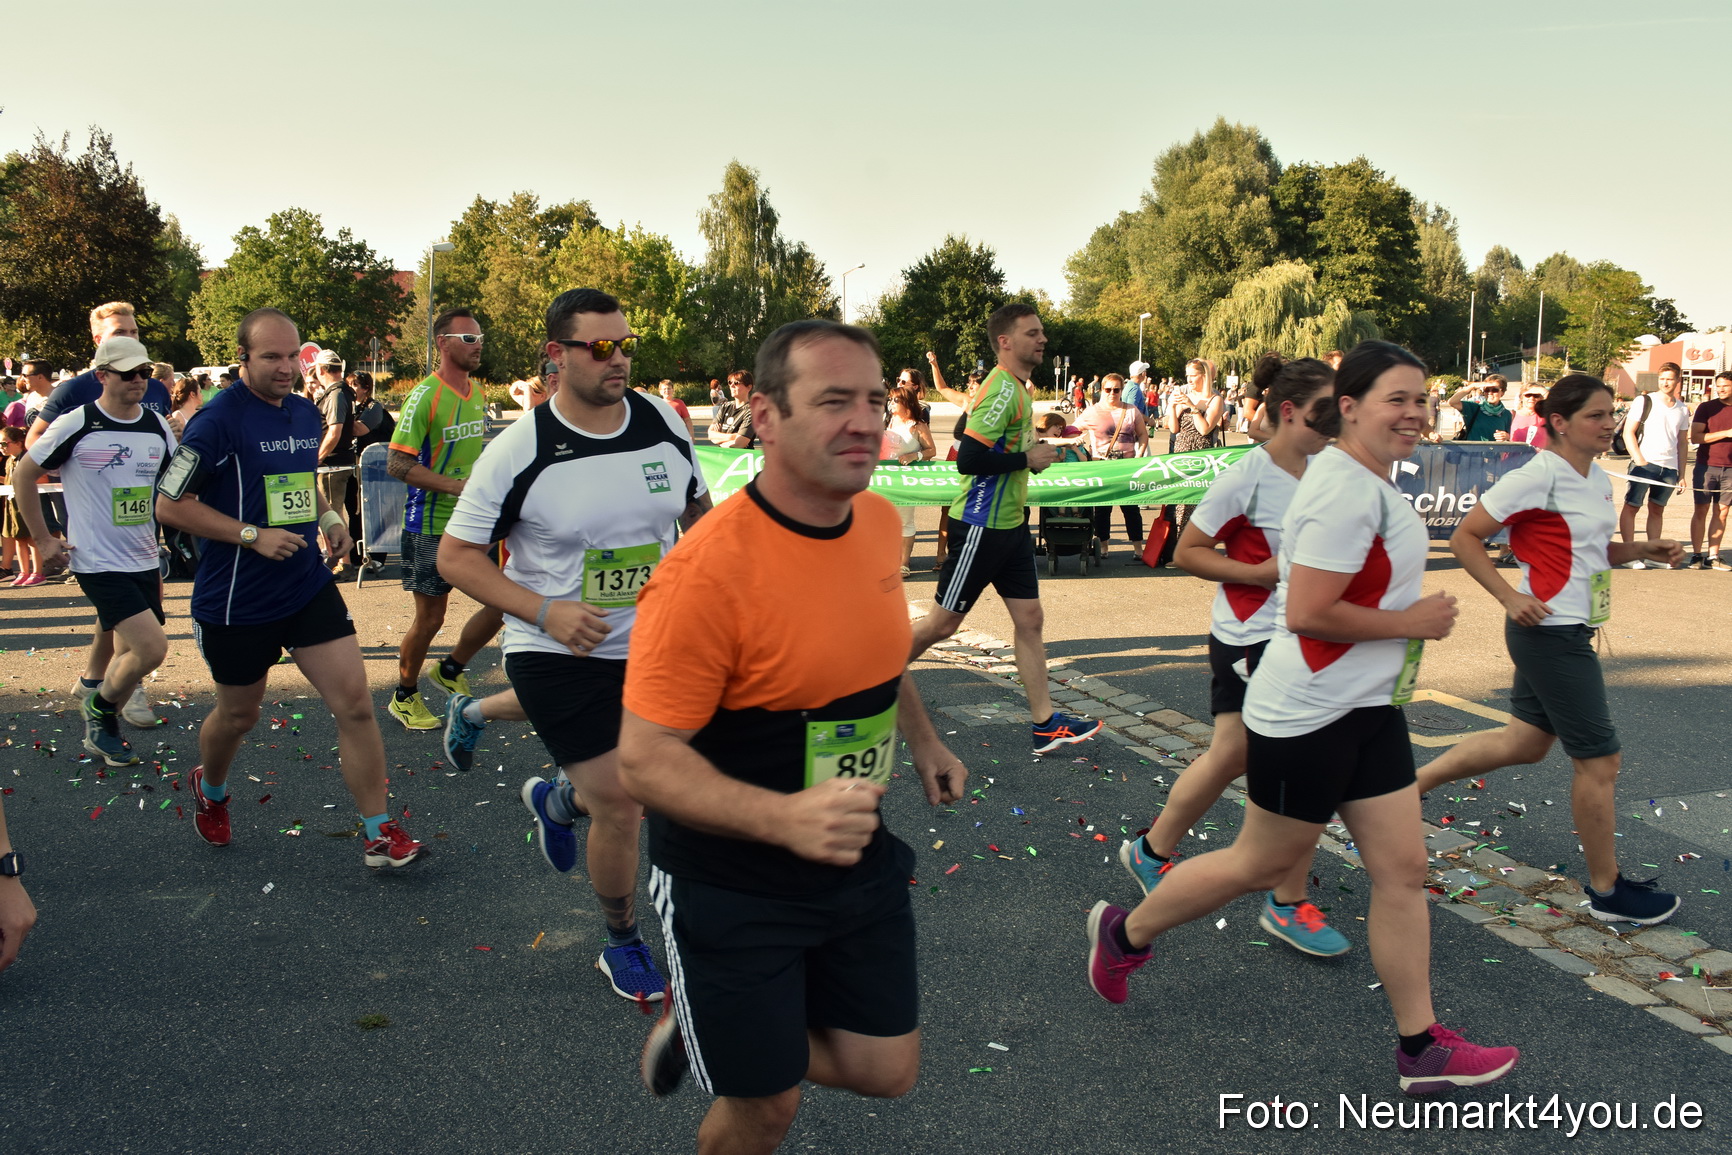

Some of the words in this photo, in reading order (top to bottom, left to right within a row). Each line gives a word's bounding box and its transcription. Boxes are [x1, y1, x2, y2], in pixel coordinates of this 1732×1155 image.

[400, 385, 430, 433] BOCK
[983, 380, 1014, 427] BOCK
[1131, 452, 1232, 480] AOK
[901, 475, 960, 486] best
[1129, 481, 1145, 491] Die
[120, 500, 150, 514] 1461
[283, 490, 311, 509] 538
[594, 565, 651, 591] 1373
[836, 736, 892, 779] 897
